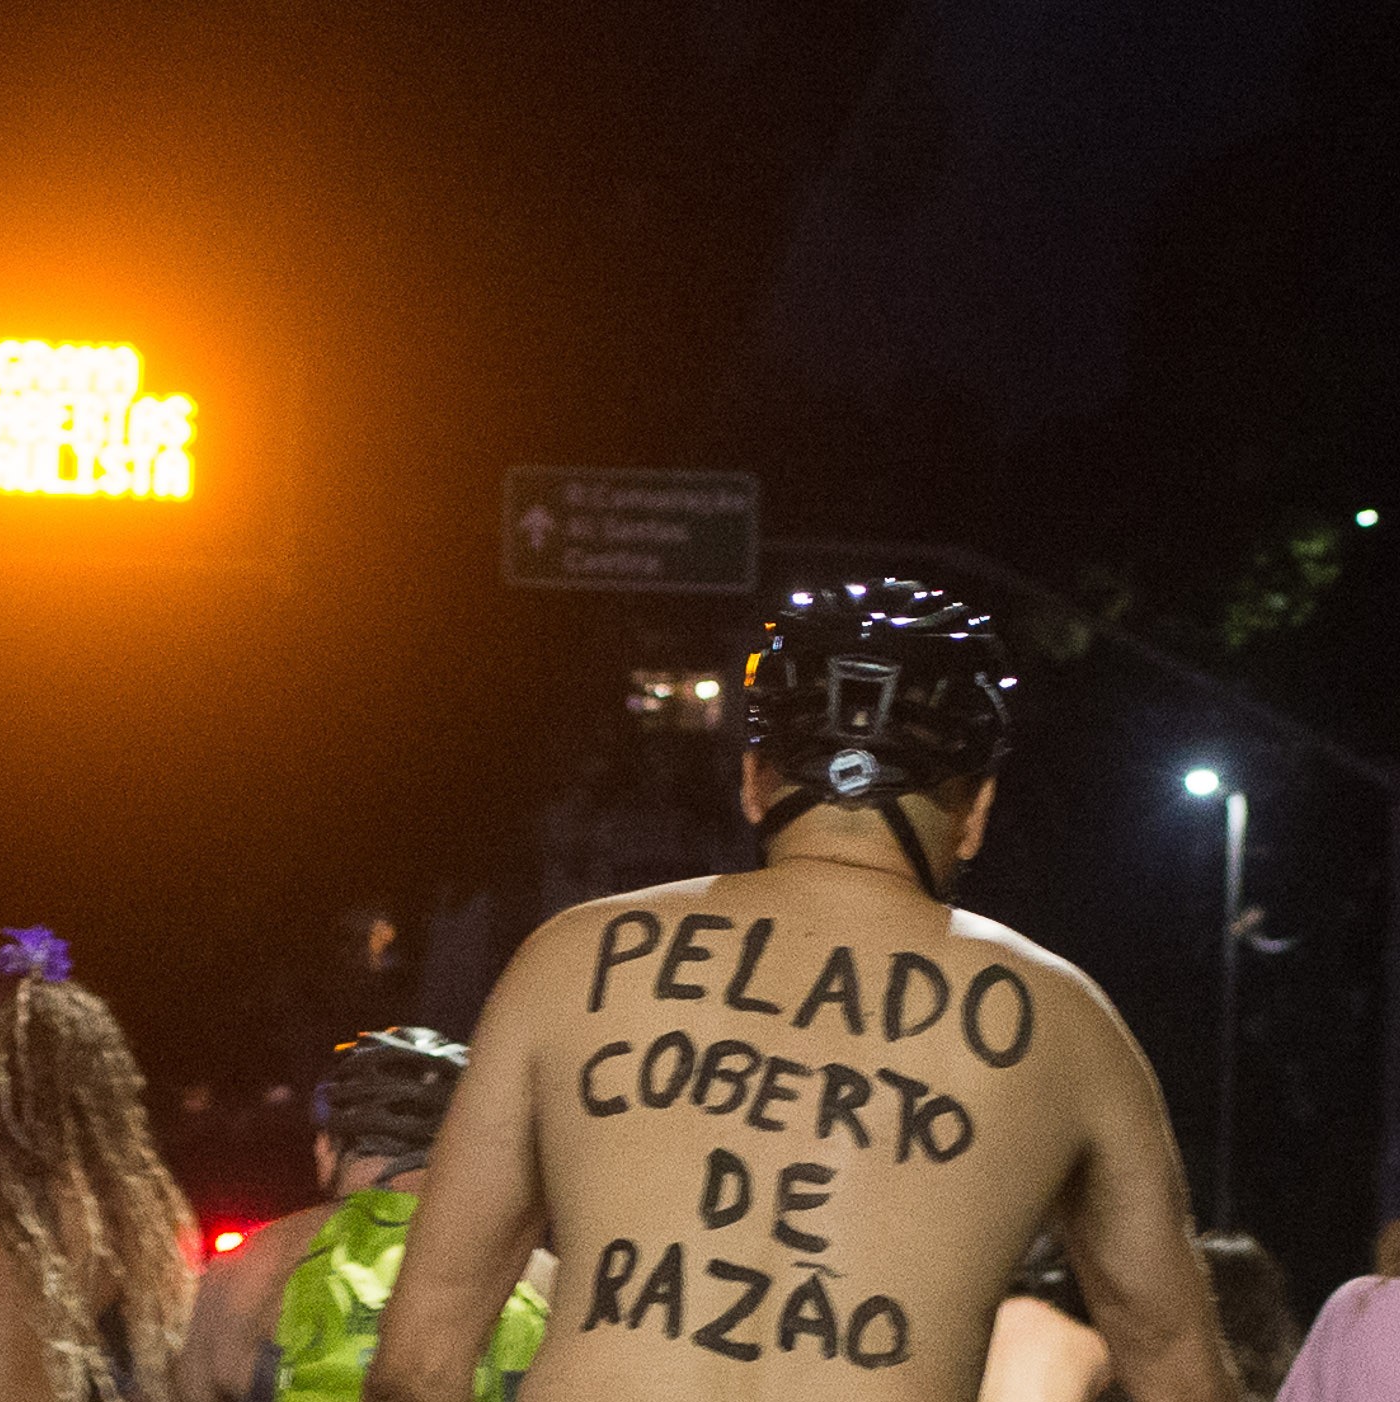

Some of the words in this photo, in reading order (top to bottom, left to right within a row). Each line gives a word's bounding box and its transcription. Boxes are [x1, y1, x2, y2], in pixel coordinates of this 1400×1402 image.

[586, 909, 1036, 1069] PELADO
[577, 1029, 976, 1164] COBERTO
[698, 1147, 838, 1254] DE
[580, 1237, 911, 1370] RAZÃO
